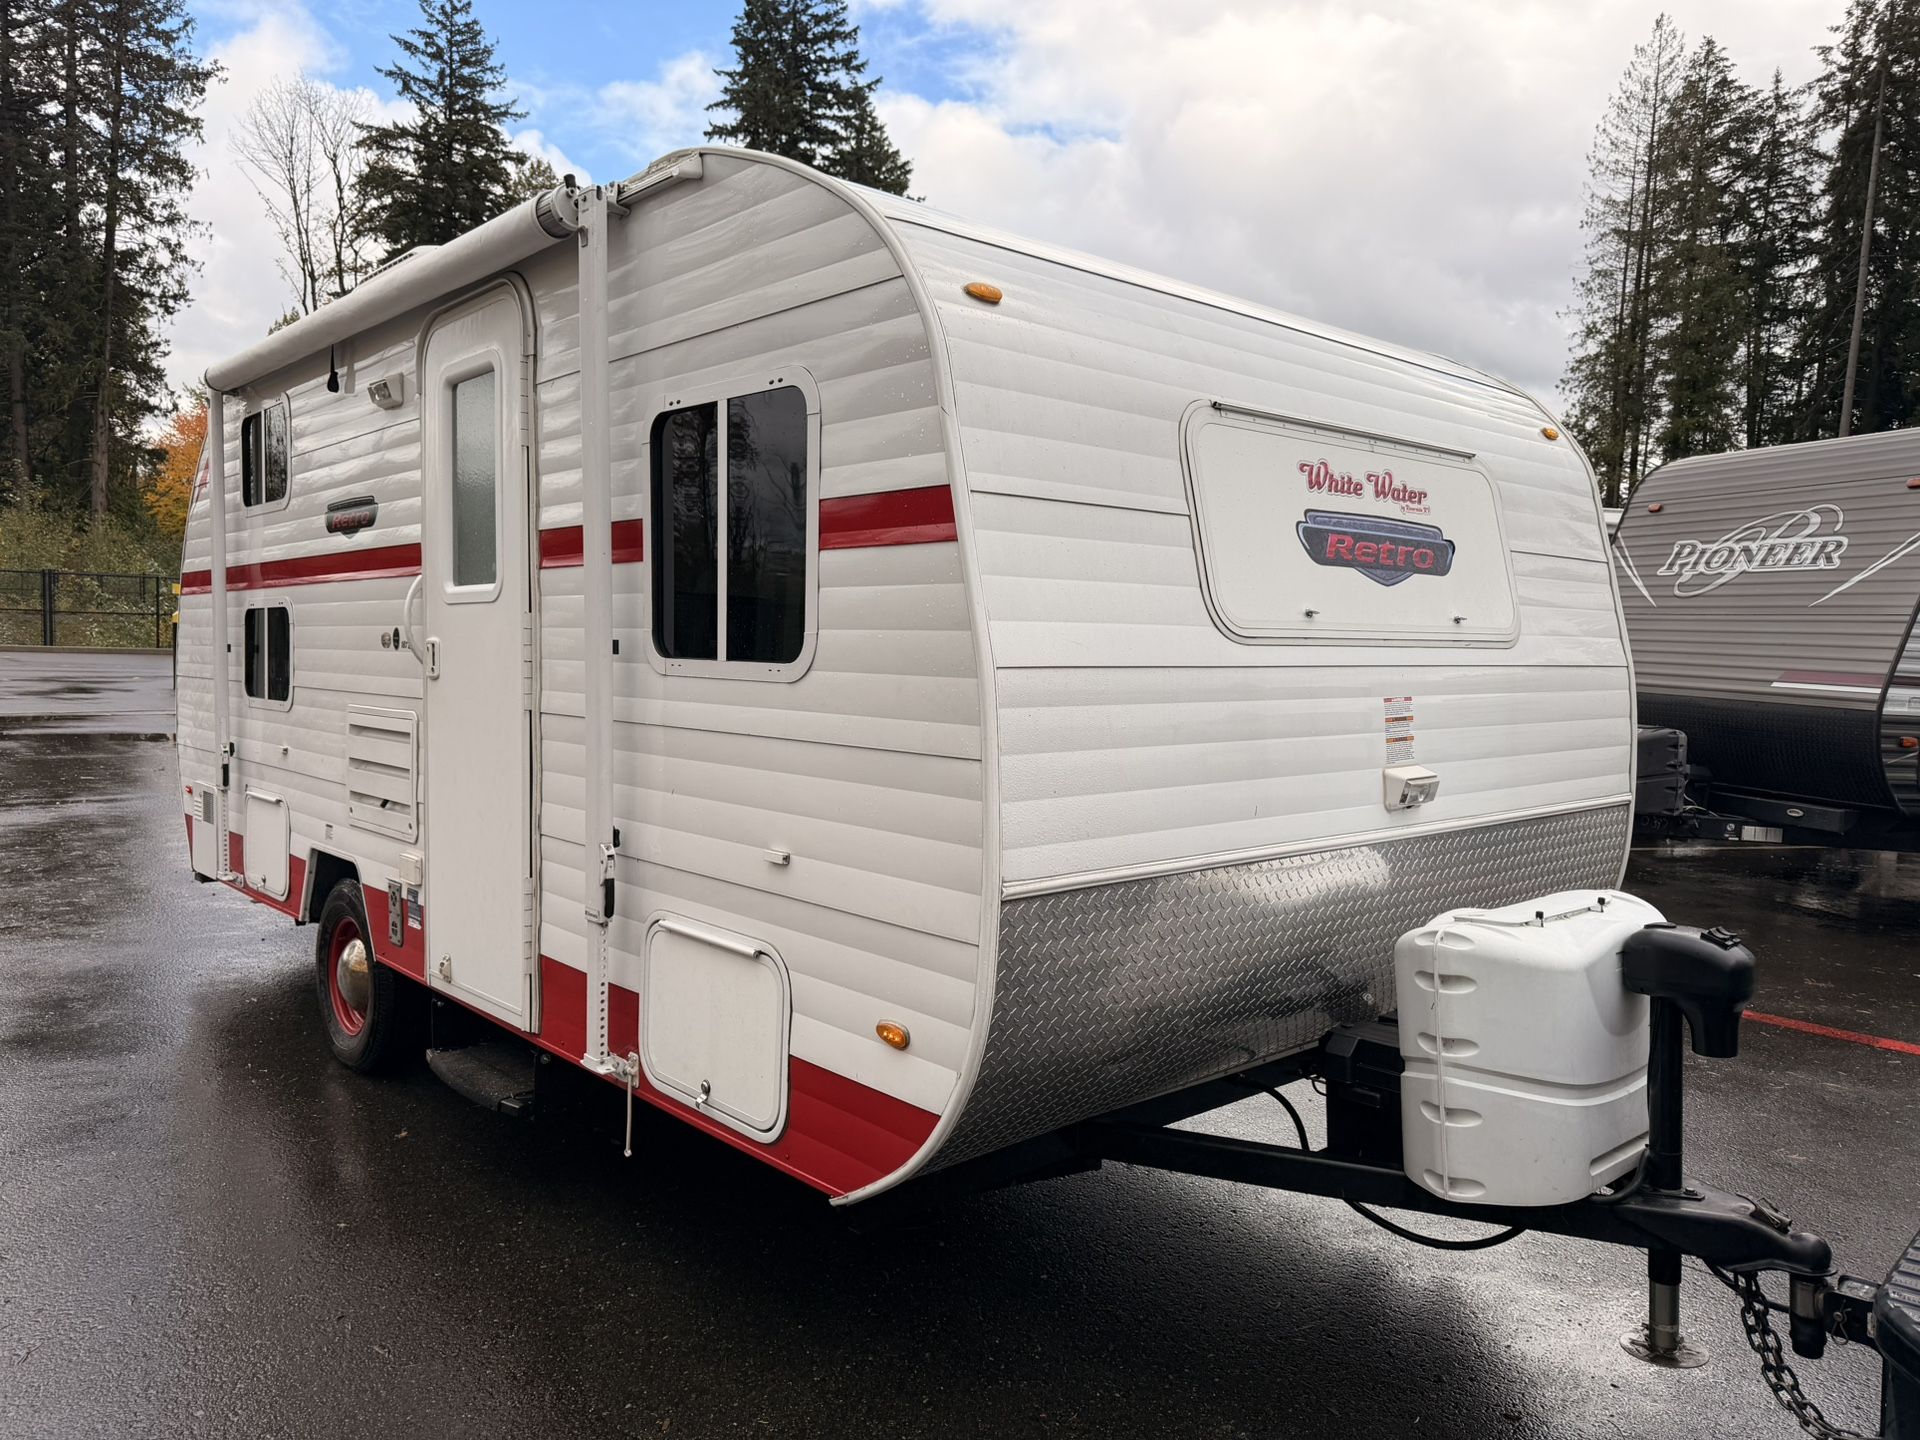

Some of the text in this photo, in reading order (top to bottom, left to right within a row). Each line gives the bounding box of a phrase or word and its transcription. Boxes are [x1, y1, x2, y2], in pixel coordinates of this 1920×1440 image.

[1299, 461, 1428, 505] White Water
[331, 511, 370, 529] Retro
[1325, 533, 1435, 569] Retro
[1659, 537, 1847, 575] PIONEER
